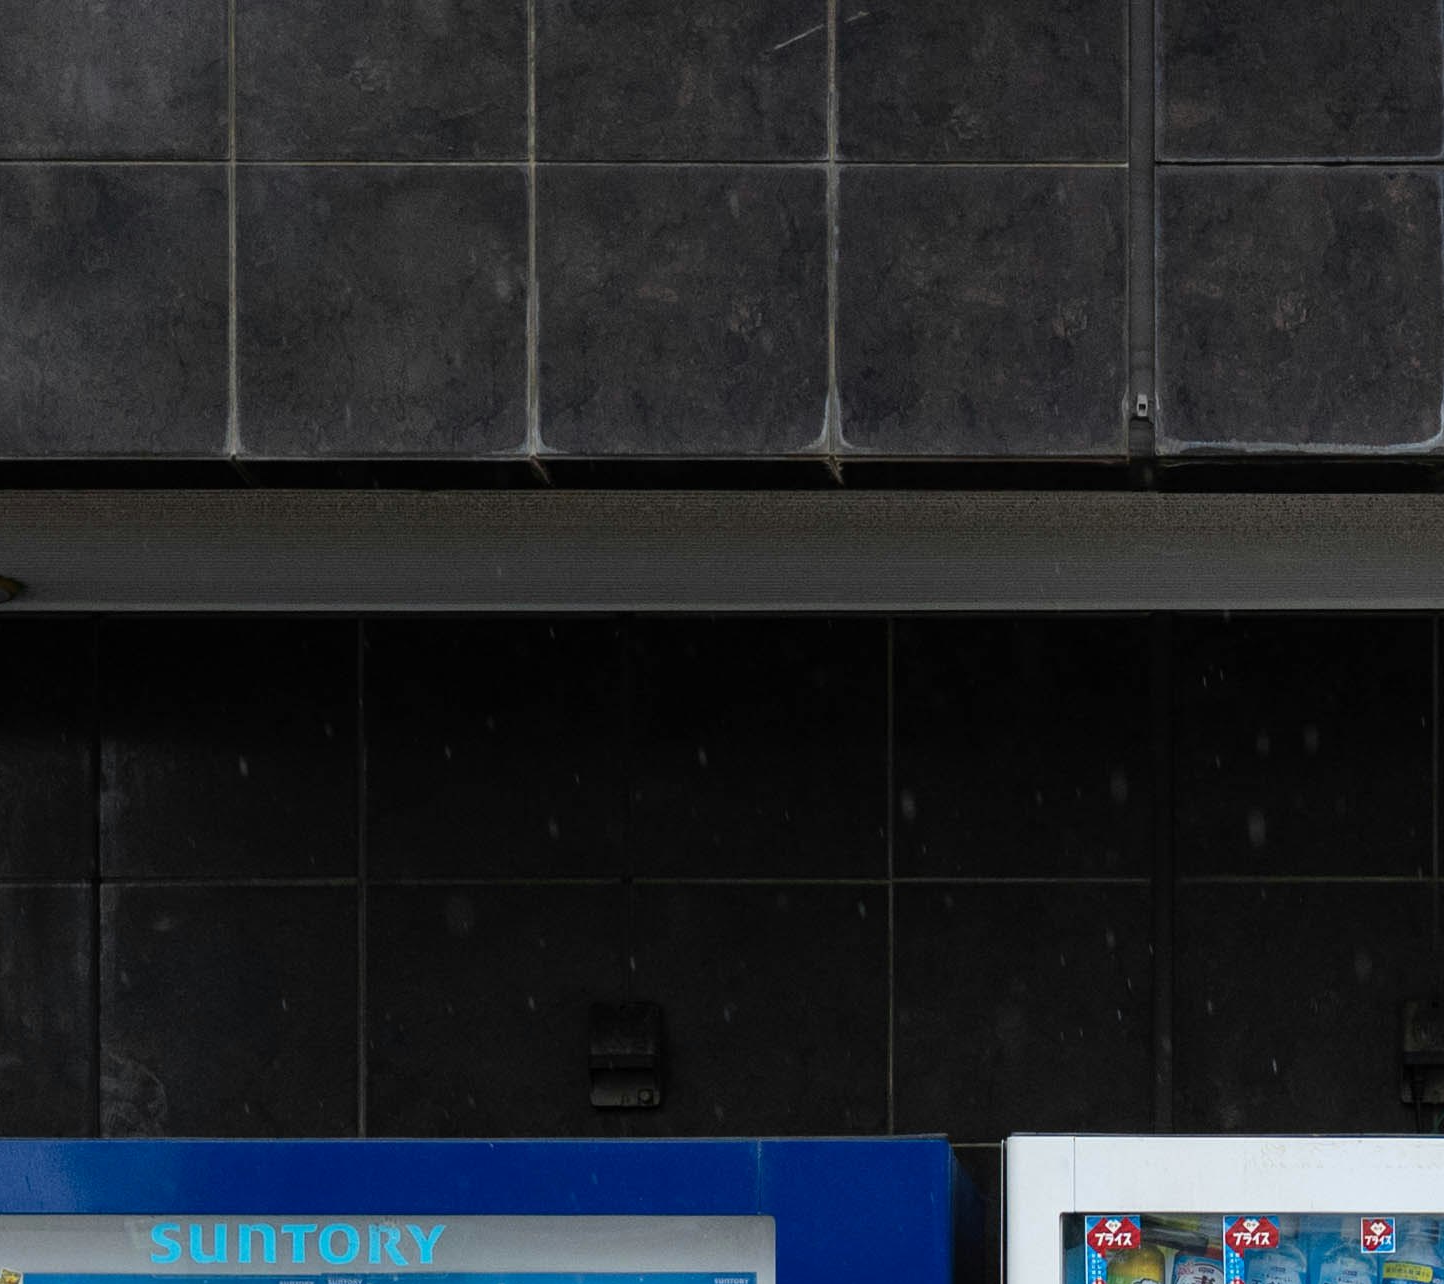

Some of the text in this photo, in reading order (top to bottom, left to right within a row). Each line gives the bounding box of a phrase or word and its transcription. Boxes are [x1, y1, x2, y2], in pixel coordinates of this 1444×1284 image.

[151, 1222, 448, 1265] SUNTORY
[1094, 1232, 1133, 1246] プライス
[1232, 1232, 1271, 1246] プライス
